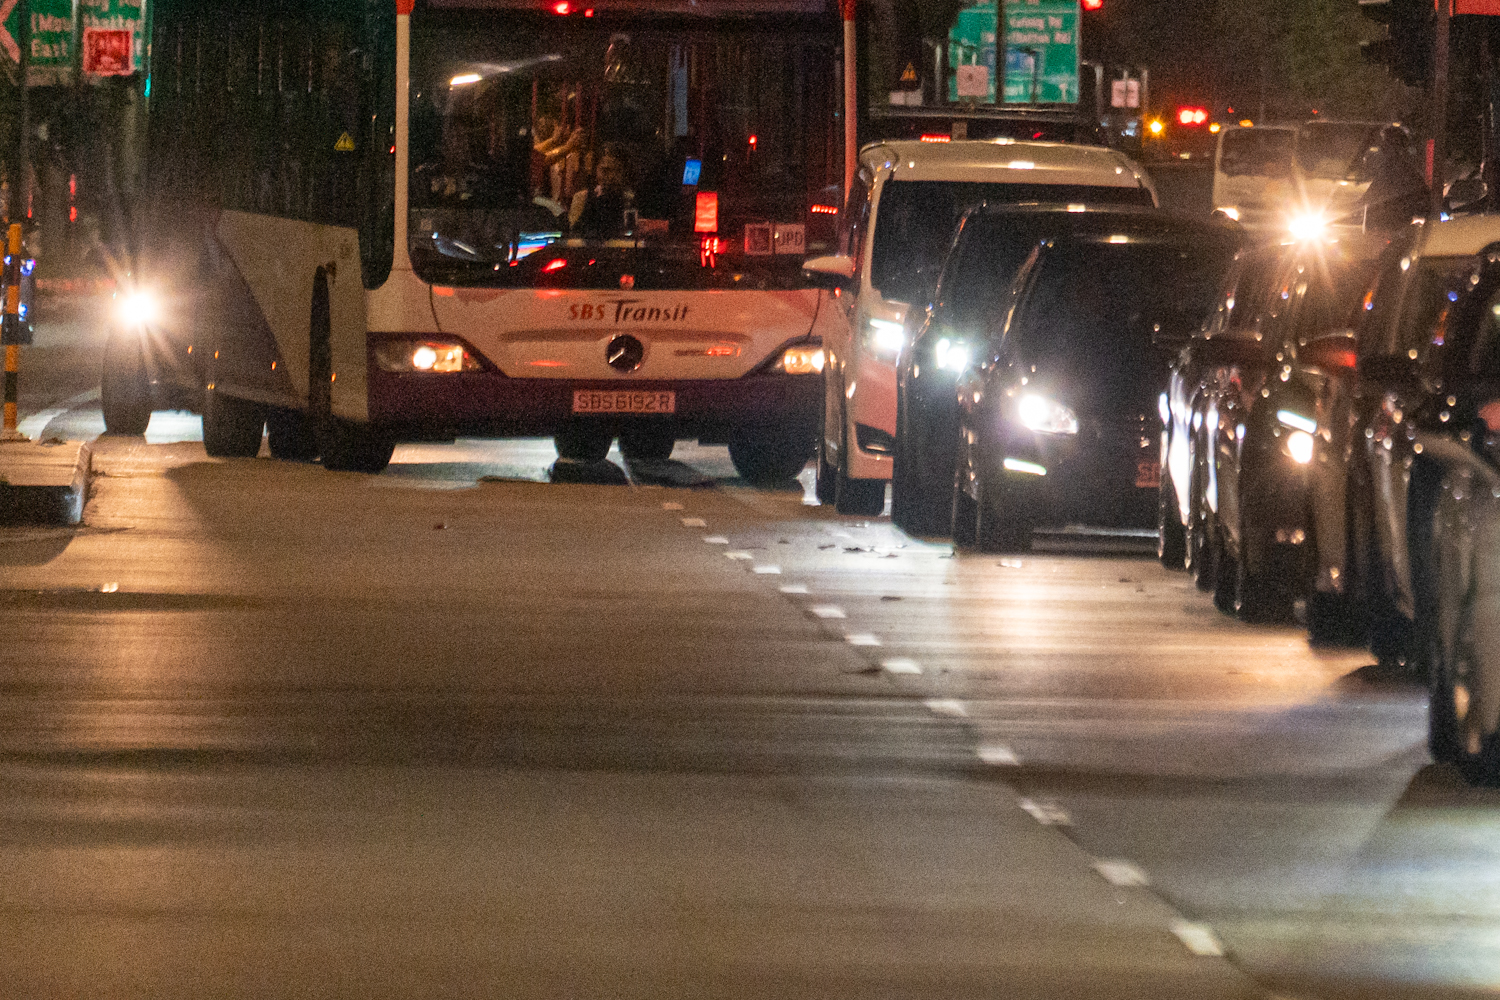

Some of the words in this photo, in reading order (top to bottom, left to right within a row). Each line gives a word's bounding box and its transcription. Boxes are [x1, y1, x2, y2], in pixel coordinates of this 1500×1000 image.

[31, 39, 68, 58] East
[569, 303, 605, 321] SBS
[606, 299, 690, 324] Transit
[577, 393, 670, 410] SBS6192R
